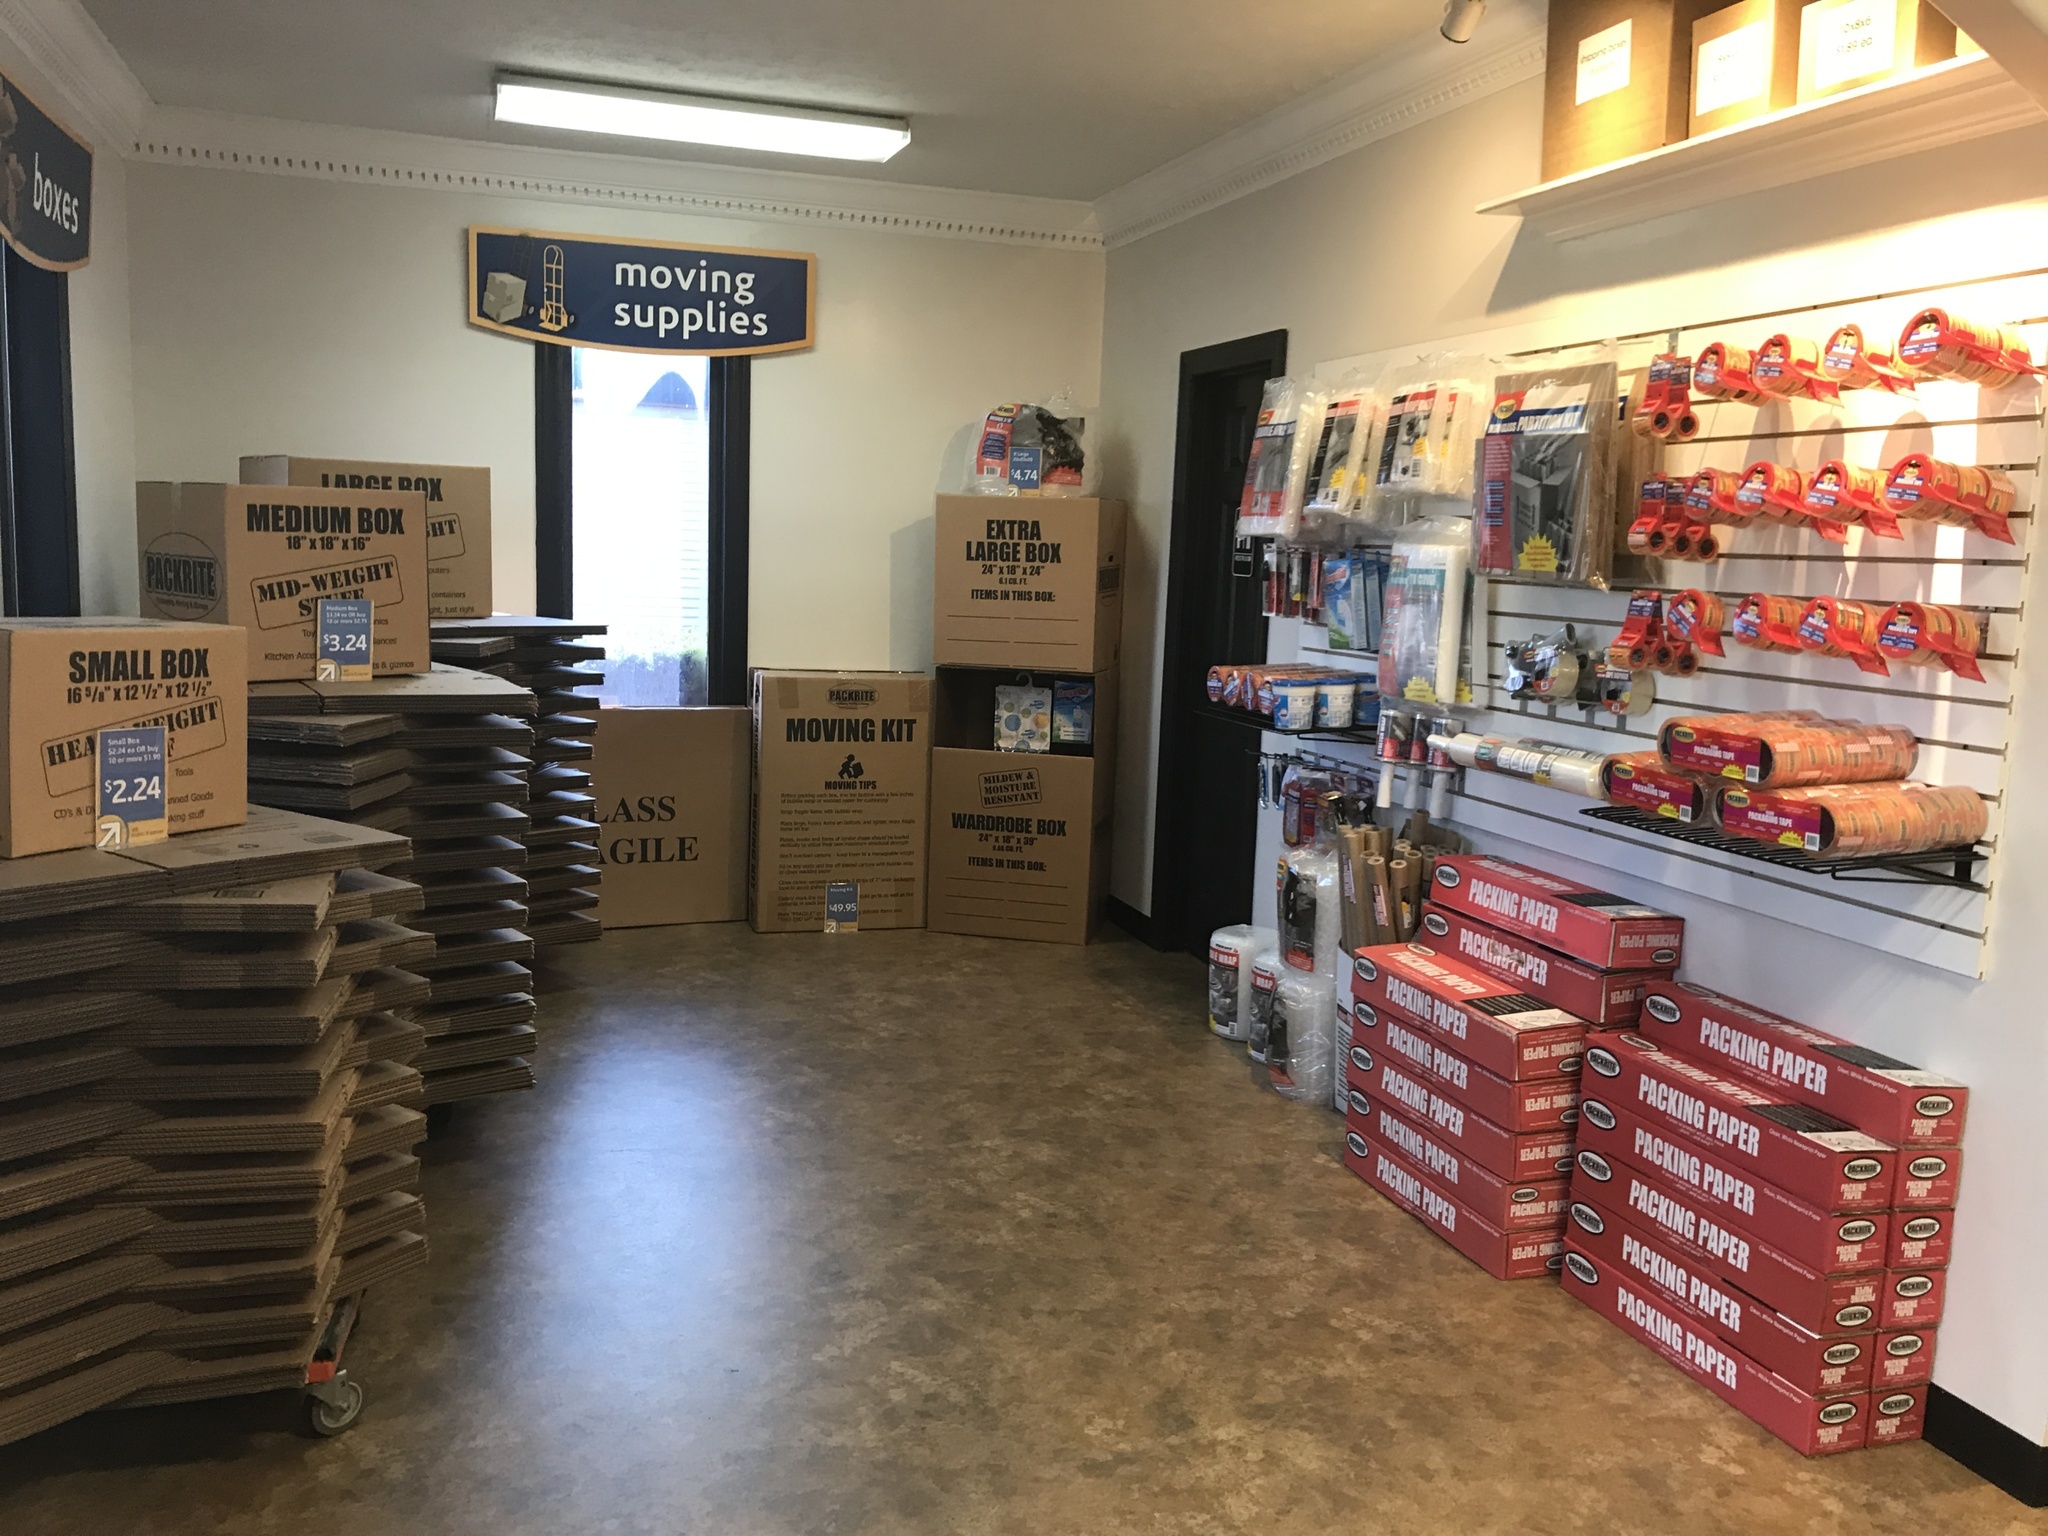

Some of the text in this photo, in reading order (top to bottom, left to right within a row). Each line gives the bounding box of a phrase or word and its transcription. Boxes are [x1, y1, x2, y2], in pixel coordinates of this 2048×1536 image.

[33, 151, 79, 235] boxes
[614, 259, 756, 306] moving
[613, 300, 769, 340] supplies
[1010, 468, 1038, 481] $4.74
[397, 476, 444, 502] BOX
[246, 503, 405, 535] MEDIUM BOX
[986, 519, 1042, 541] EXTRA
[966, 540, 1062, 563] LARGE BOX
[146, 555, 216, 597] PACKRITE
[256, 561, 395, 603] MID-WEIGHT
[971, 588, 1056, 602] ITEMS IN THIS BOX:
[323, 633, 368, 652] $3.24
[68, 647, 210, 684] SMALL BOX
[264, 651, 294, 661] Kitchen
[67, 686, 82, 704] 16
[125, 685, 139, 700] 12
[175, 683, 189, 698] 12
[829, 689, 876, 702] PACKRITE
[785, 717, 917, 742] MOVING KIT
[108, 738, 127, 746] Small
[175, 767, 194, 777] Tools
[983, 771, 1035, 785] MILDEW &
[104, 775, 161, 804] $2.24
[191, 791, 214, 802] Goods
[824, 780, 877, 790] MOVING TIPS
[984, 781, 1037, 795] MOISTURE
[983, 791, 1040, 806] RESISTANT
[951, 812, 1067, 837] WARDROBE BOX
[968, 856, 994, 868] ITEMS
[995, 858, 1004, 869] IN
[1006, 859, 1026, 870] THIS
[828, 903, 857, 913] $49.95
[1468, 878, 1559, 933] PACKING PAPER
[1619, 933, 1680, 948] PACKING PAPER
[1220, 954, 1238, 966] WRAP
[1459, 928, 1548, 987] PACKING PAPER
[1256, 975, 1274, 989] WRAP
[1385, 975, 1468, 1040] PACKING PAPER
[1649, 997, 1679, 1020] PACKRITE
[1386, 1021, 1432, 1063] PACKING
[1434, 1045, 1469, 1090] PAPER
[1589, 1050, 1618, 1074] PACKRITE
[1700, 1017, 1828, 1096] PACKING PAPER
[1381, 1065, 1464, 1137] PACKING PAPER
[1919, 1099, 1950, 1111] PACKRITE
[1638, 1074, 1761, 1158] PACKING PAPER
[1379, 1110, 1459, 1185] PACKING PAPER
[1634, 1127, 1756, 1217] PACKING PAPER
[1847, 1162, 1878, 1174] PACKRITE
[1912, 1161, 1943, 1173] PACKRITE
[1376, 1154, 1457, 1233] PACKING PAPER
[1629, 1178, 1751, 1273] PACKING PAPER
[1907, 1221, 1938, 1233] PACKRITE
[1622, 1233, 1742, 1333] PACKING PAPER
[1616, 1286, 1738, 1391] PACKING PAPER
[1823, 1407, 1853, 1420] PACKRITE
